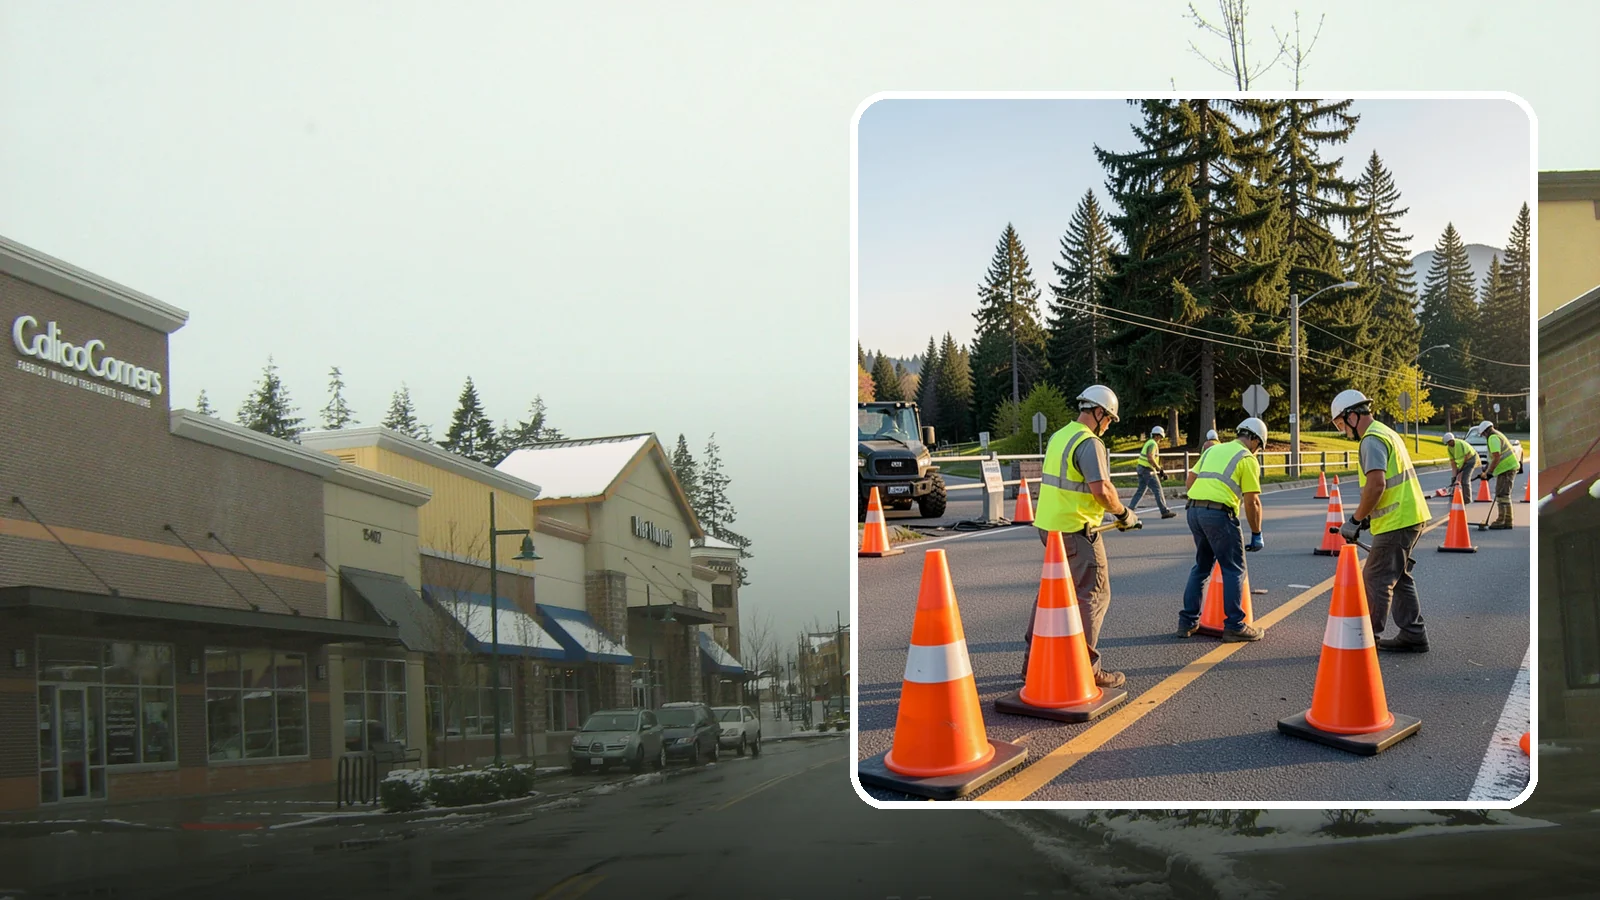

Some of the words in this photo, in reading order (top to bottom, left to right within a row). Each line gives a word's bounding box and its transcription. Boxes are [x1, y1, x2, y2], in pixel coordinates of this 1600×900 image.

[12, 315, 162, 396] CalicoCorners
[17, 359, 47, 378] FABRICS
[51, 370, 78, 387] WINDOW
[78, 378, 117, 399] TREATMENTS
[120, 391, 151, 409] FURNITURE
